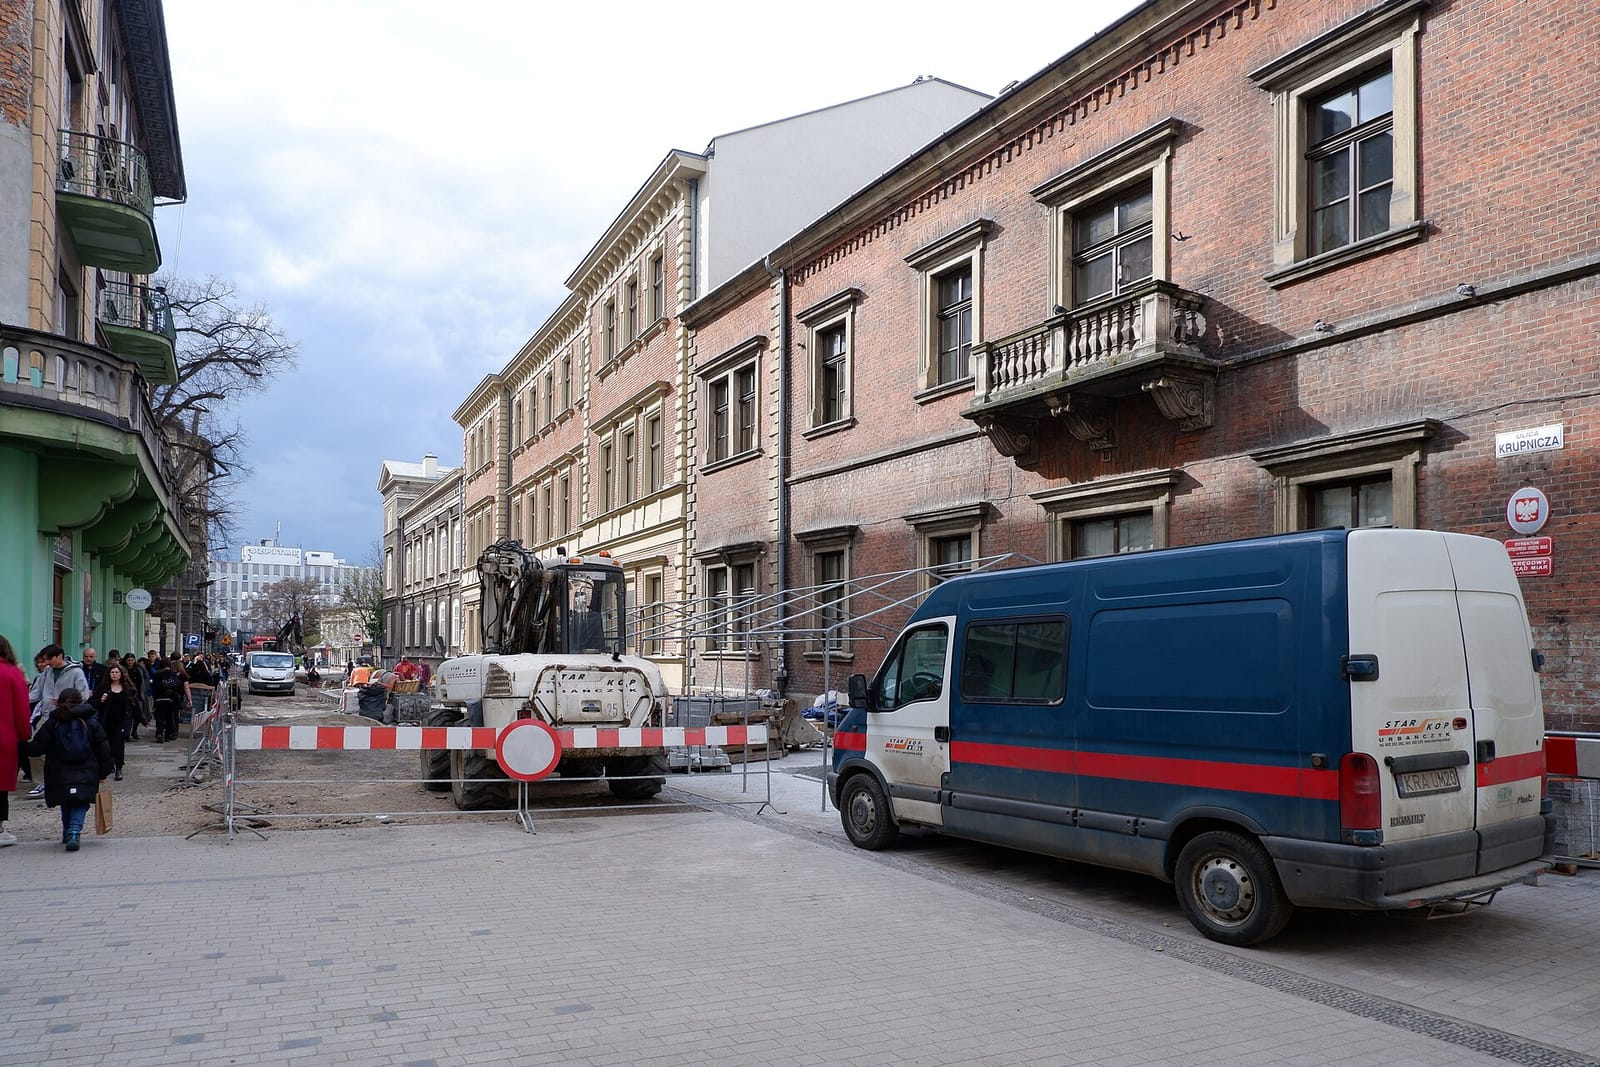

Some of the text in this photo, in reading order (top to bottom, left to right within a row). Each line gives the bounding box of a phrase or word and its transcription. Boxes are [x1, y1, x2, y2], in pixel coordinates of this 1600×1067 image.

[1516, 430, 1539, 439] ULICA
[1499, 436, 1559, 454] KRUPNICZA
[188, 635, 198, 644] P
[1385, 719, 1450, 731] STAR KOP
[1403, 774, 1430, 791] KRA
